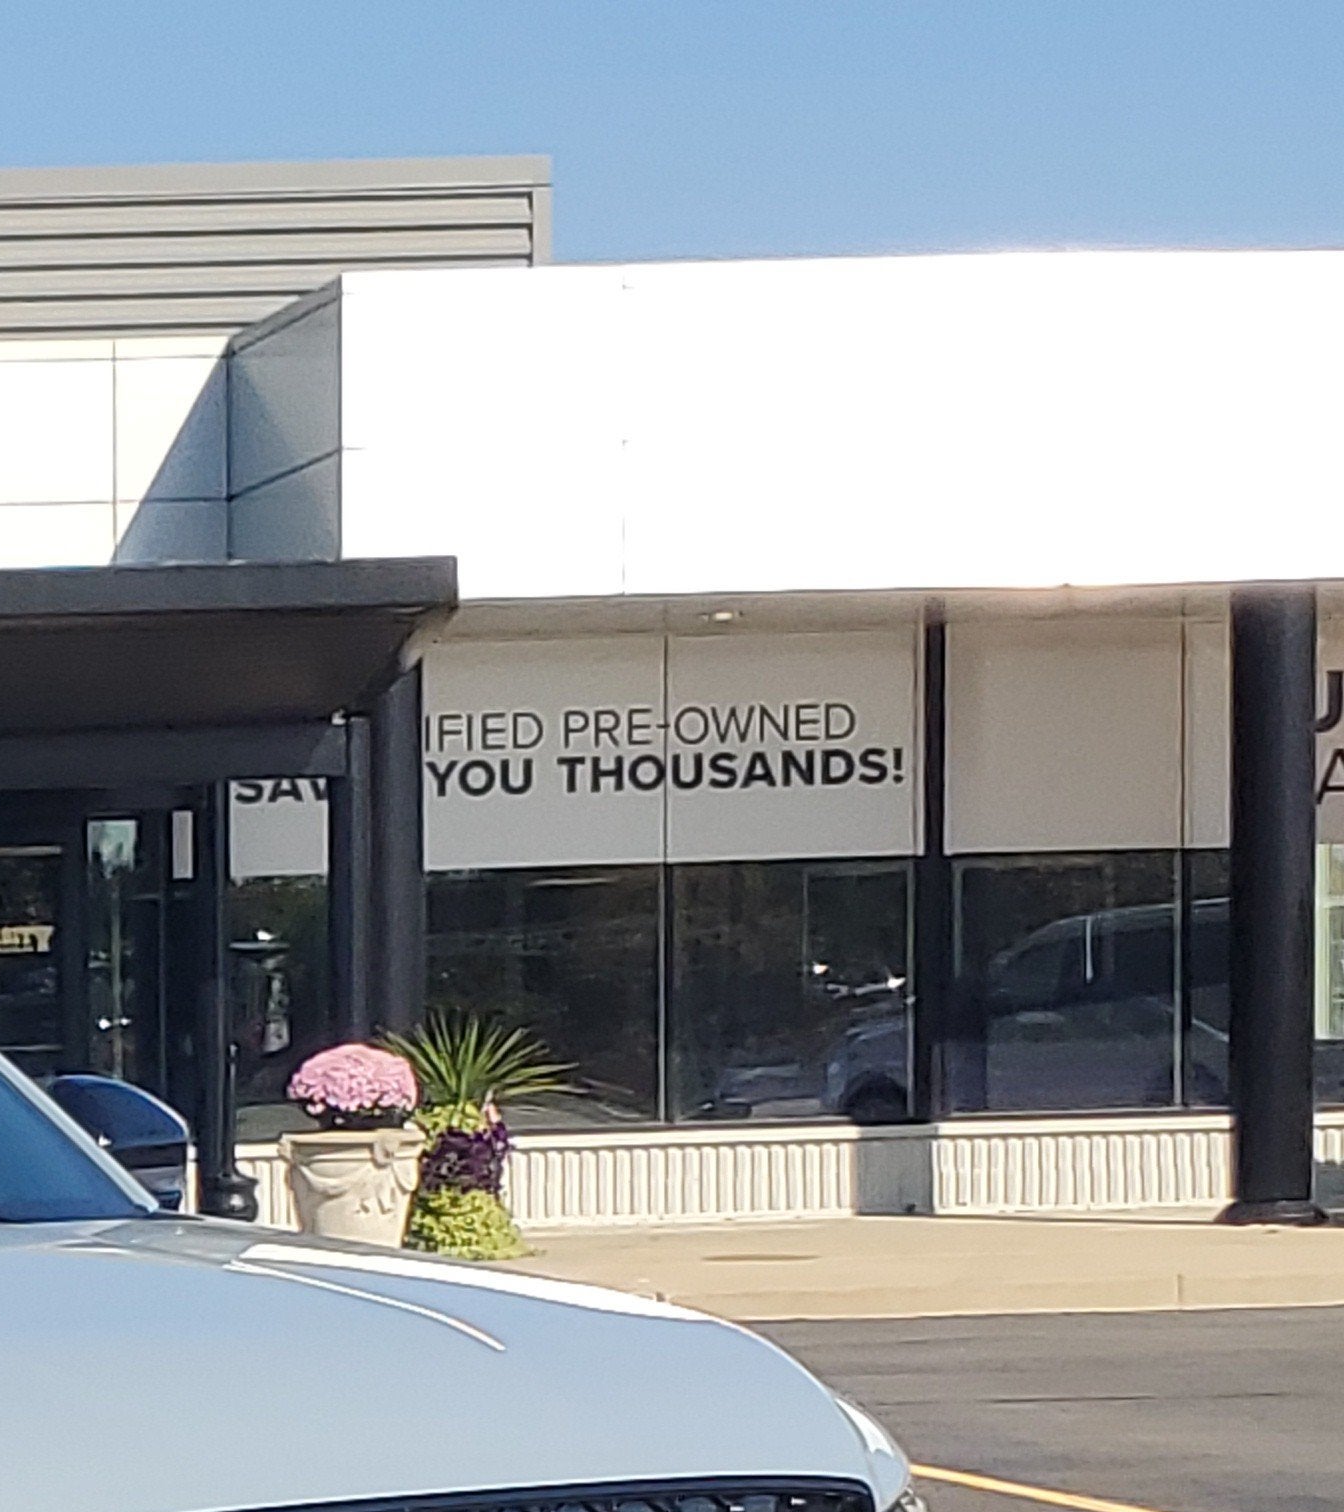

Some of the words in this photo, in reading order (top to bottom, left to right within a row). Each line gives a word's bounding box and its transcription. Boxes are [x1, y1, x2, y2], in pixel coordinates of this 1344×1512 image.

[563, 702, 856, 749] PRE-OWNED
[425, 758, 533, 797] YOU
[557, 747, 903, 793] THOUSANDS!
